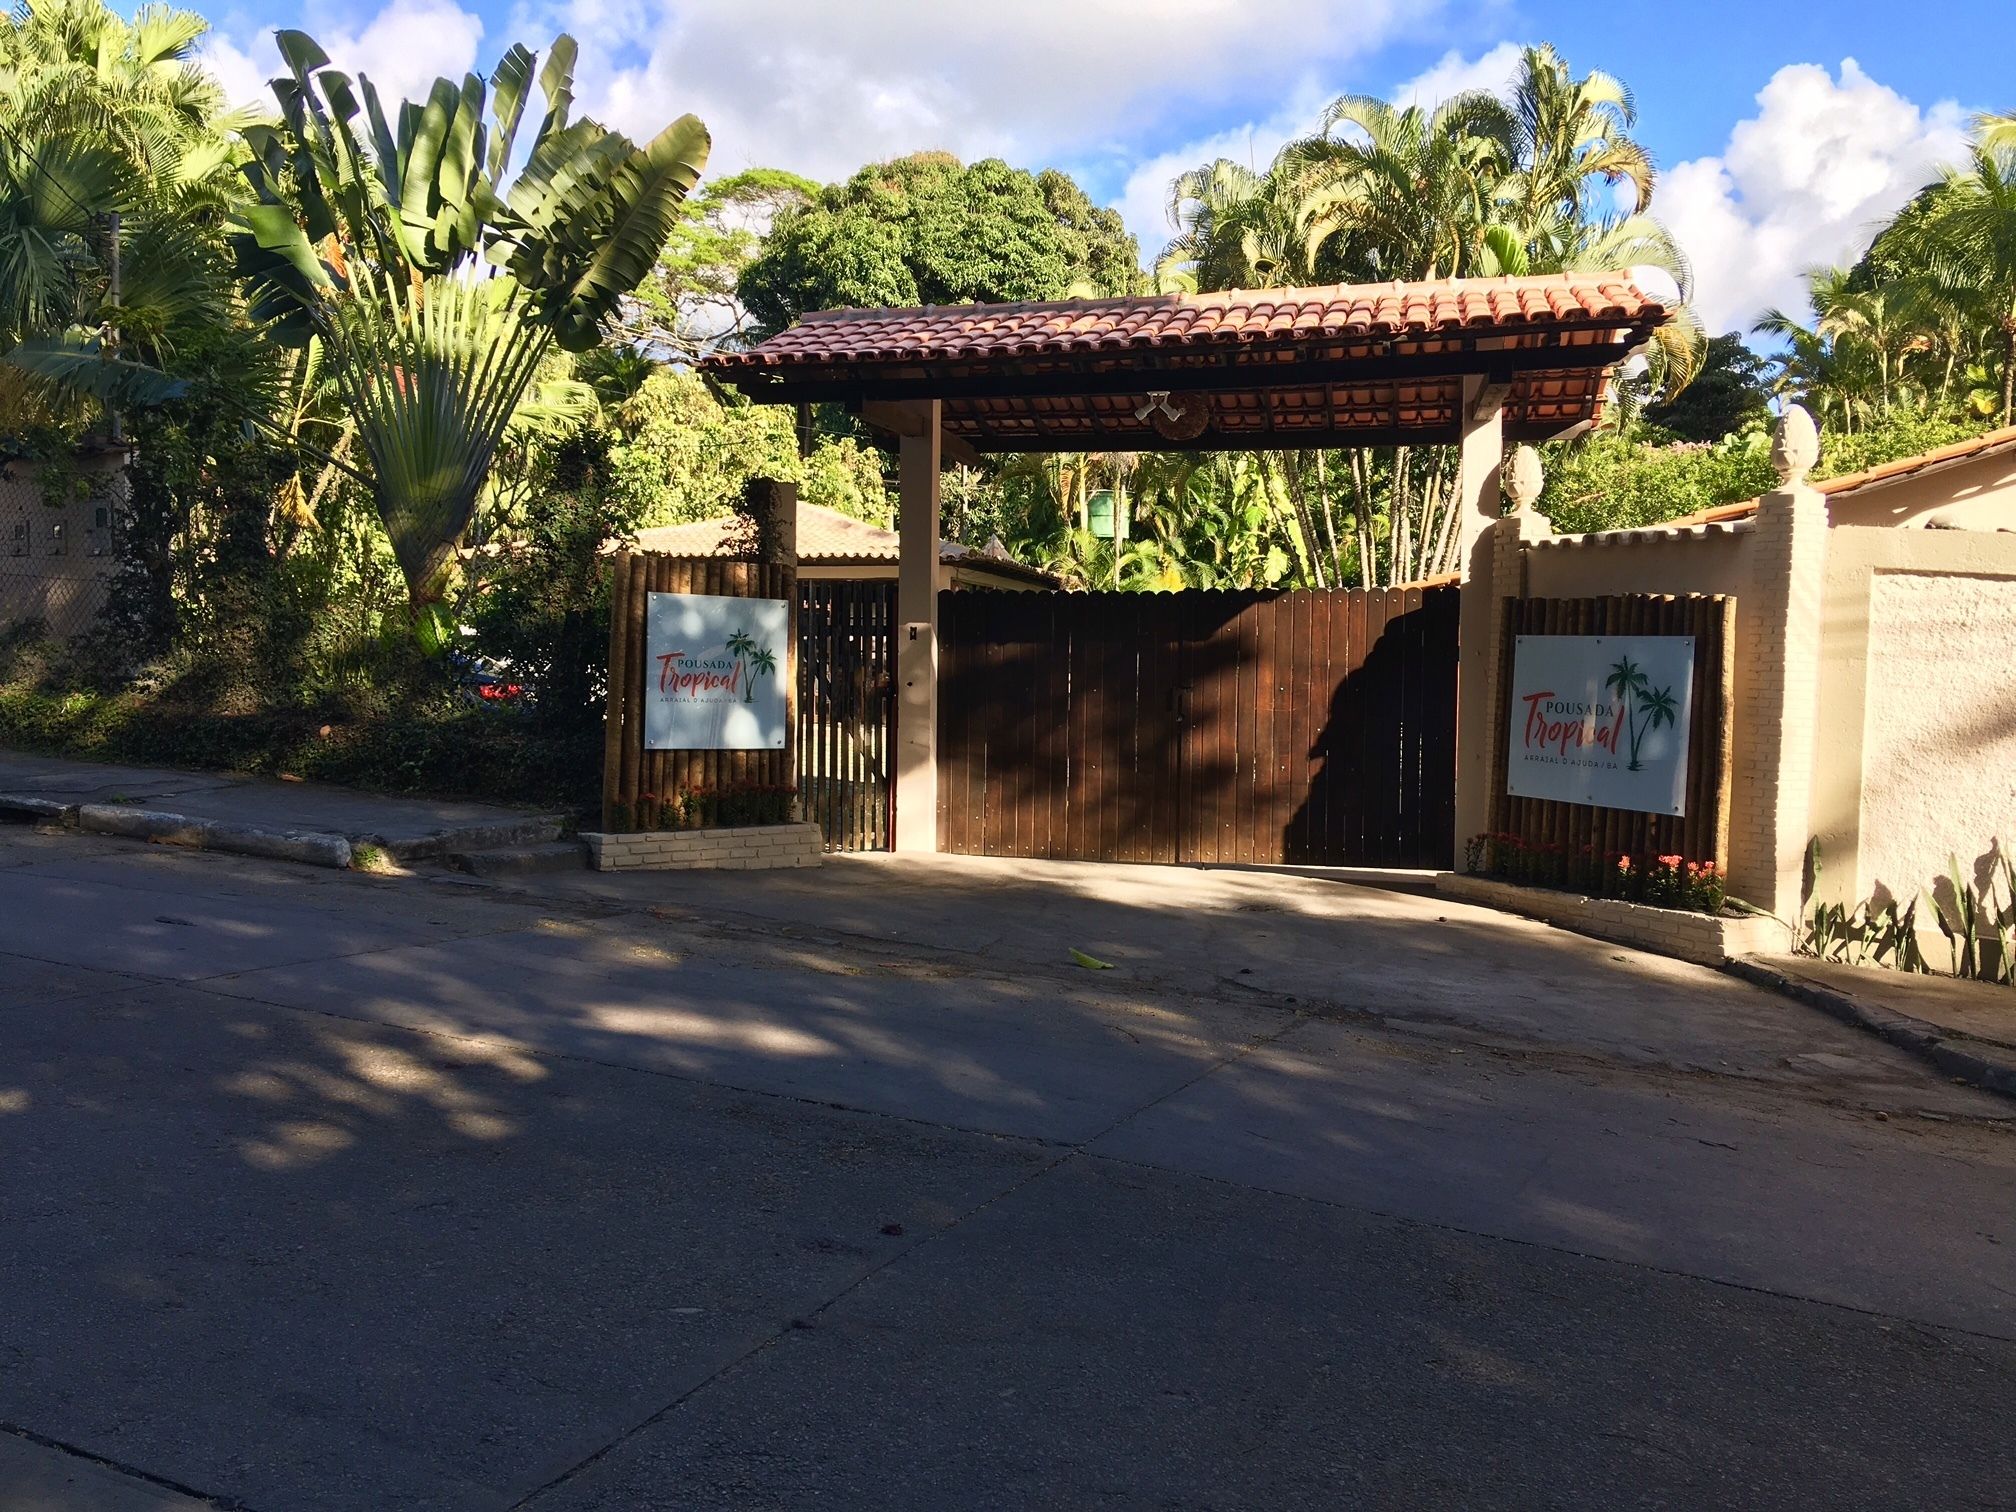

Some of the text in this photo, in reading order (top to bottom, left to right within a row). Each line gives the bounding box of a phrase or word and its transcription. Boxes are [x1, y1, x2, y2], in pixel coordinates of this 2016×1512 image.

[656, 652, 740, 697] Tropical
[678, 659, 733, 669] POUSADA
[1522, 692, 1625, 755] Tropical
[1546, 701, 1614, 717] POUSADA
